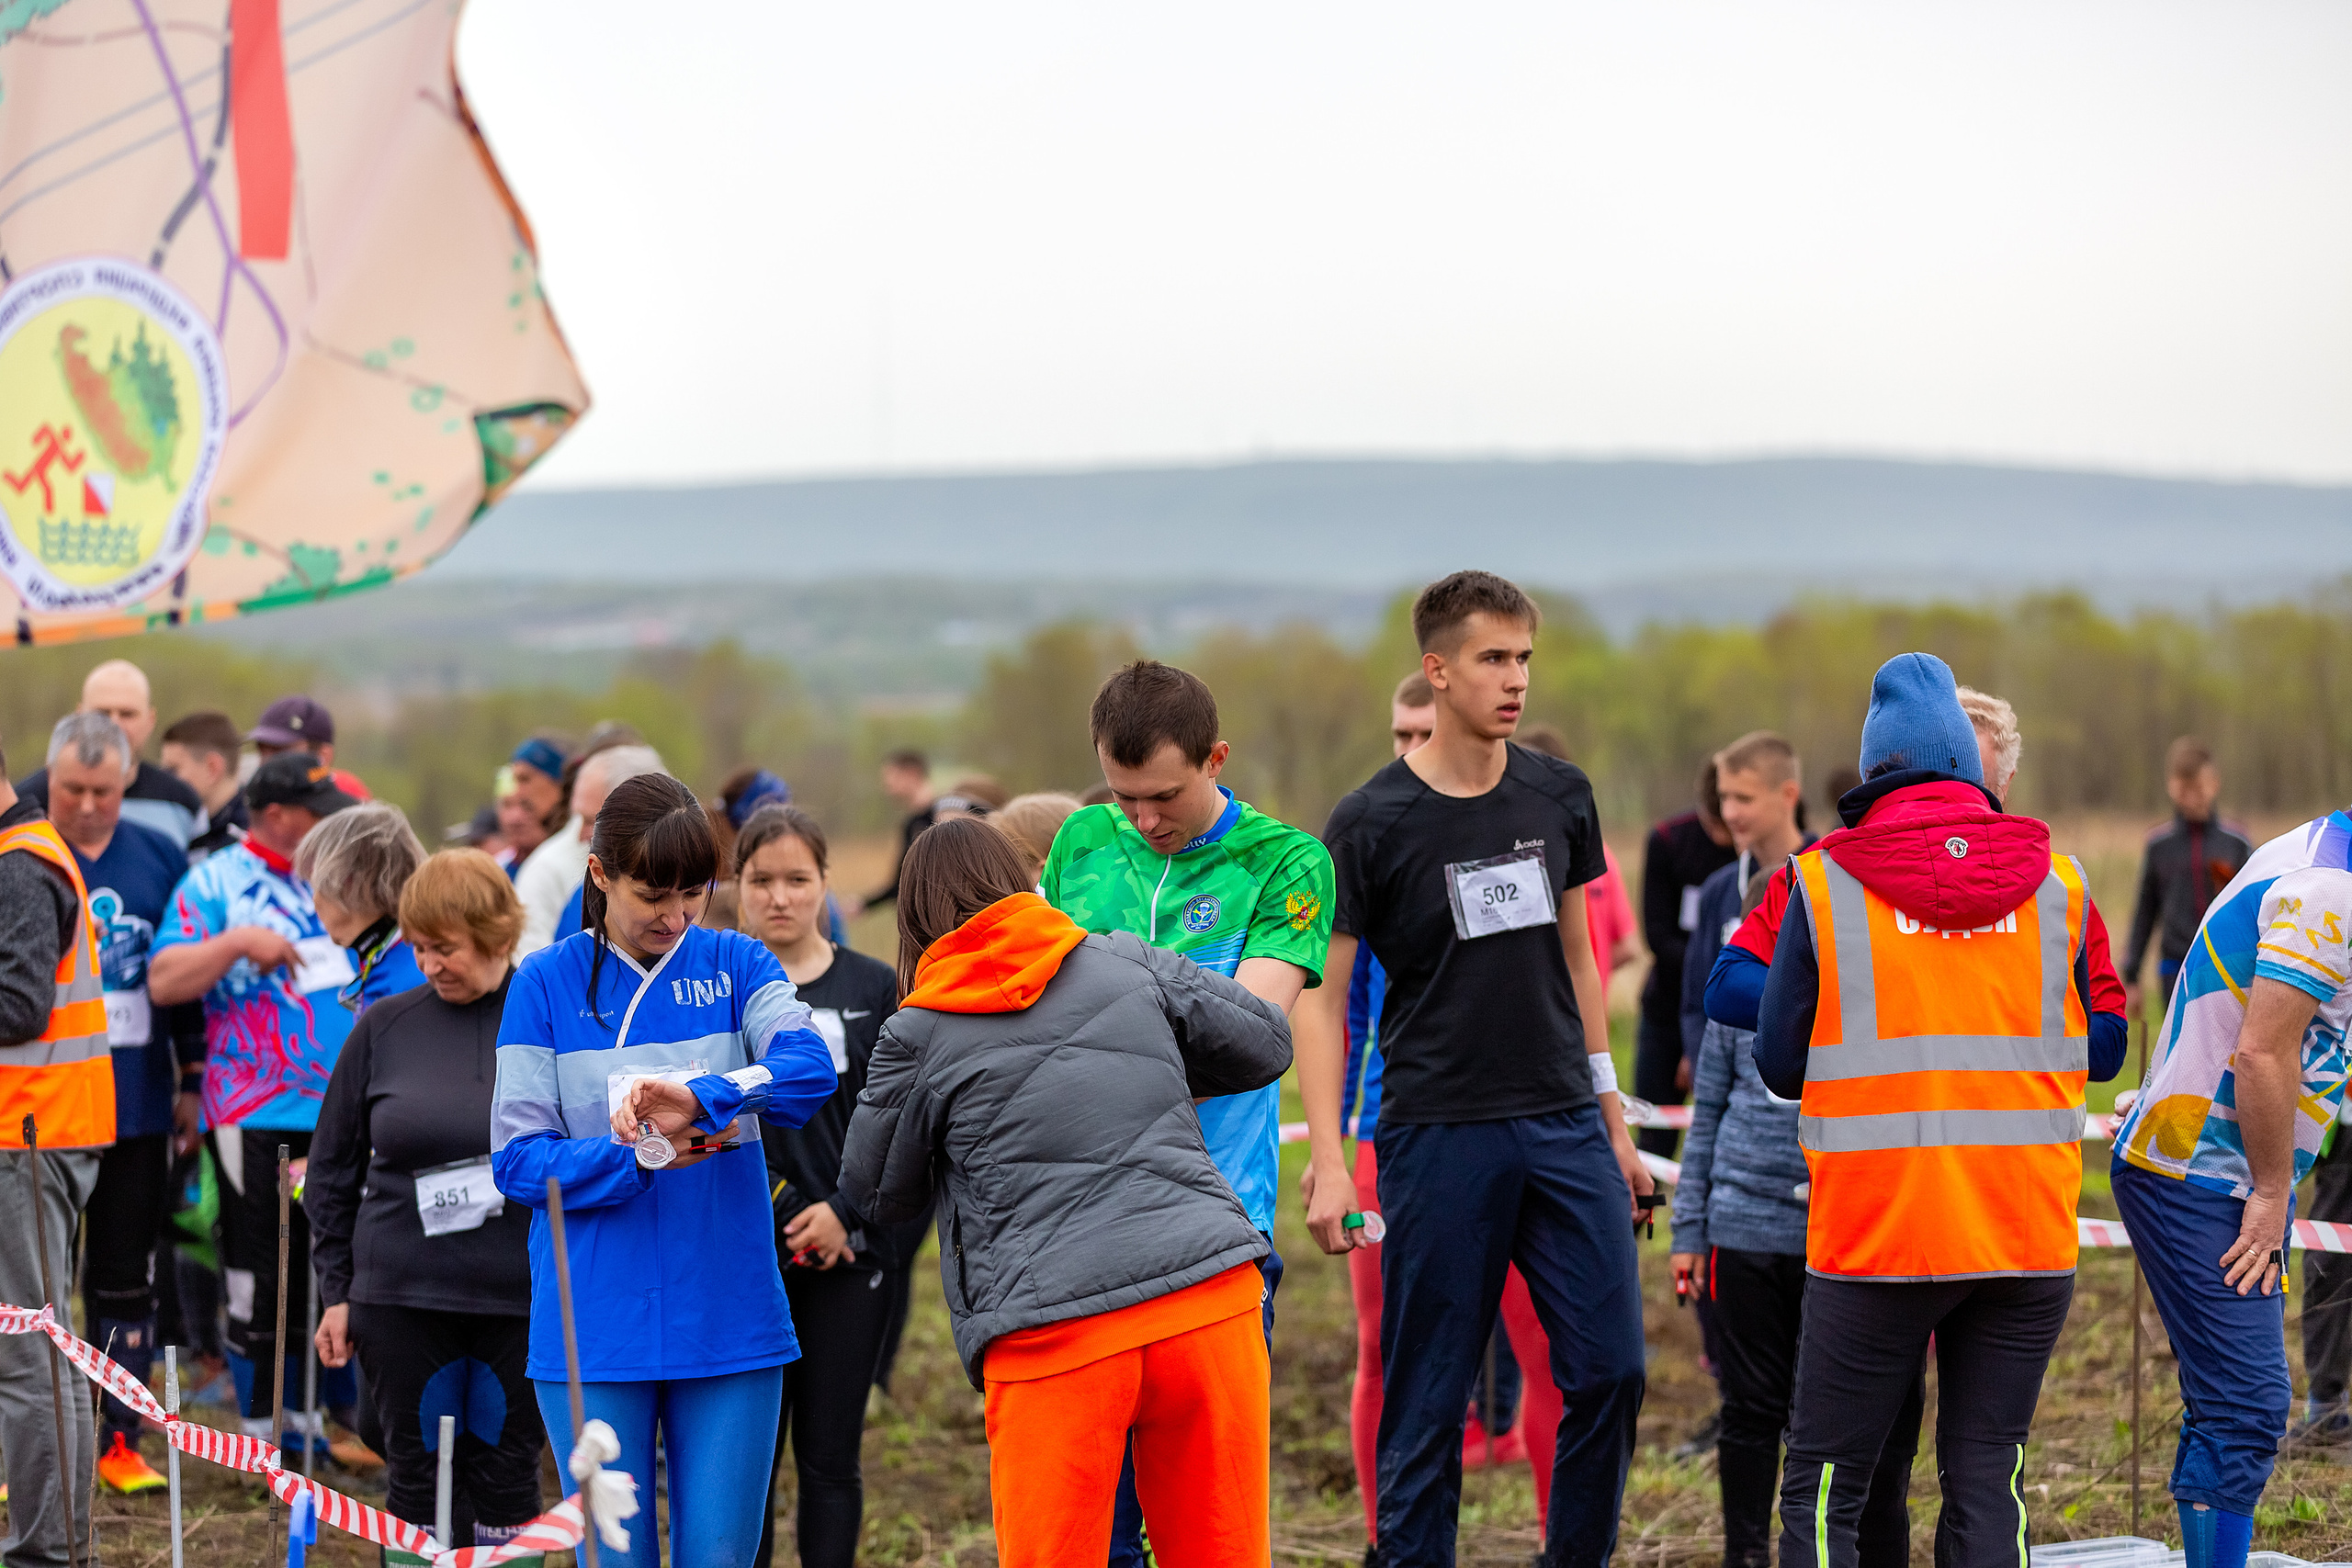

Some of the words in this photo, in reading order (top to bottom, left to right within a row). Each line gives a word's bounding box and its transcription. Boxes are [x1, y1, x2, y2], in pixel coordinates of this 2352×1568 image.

[1483, 883, 1519, 906] 502
[671, 970, 732, 1008] UNO
[435, 1186, 469, 1208] 851
